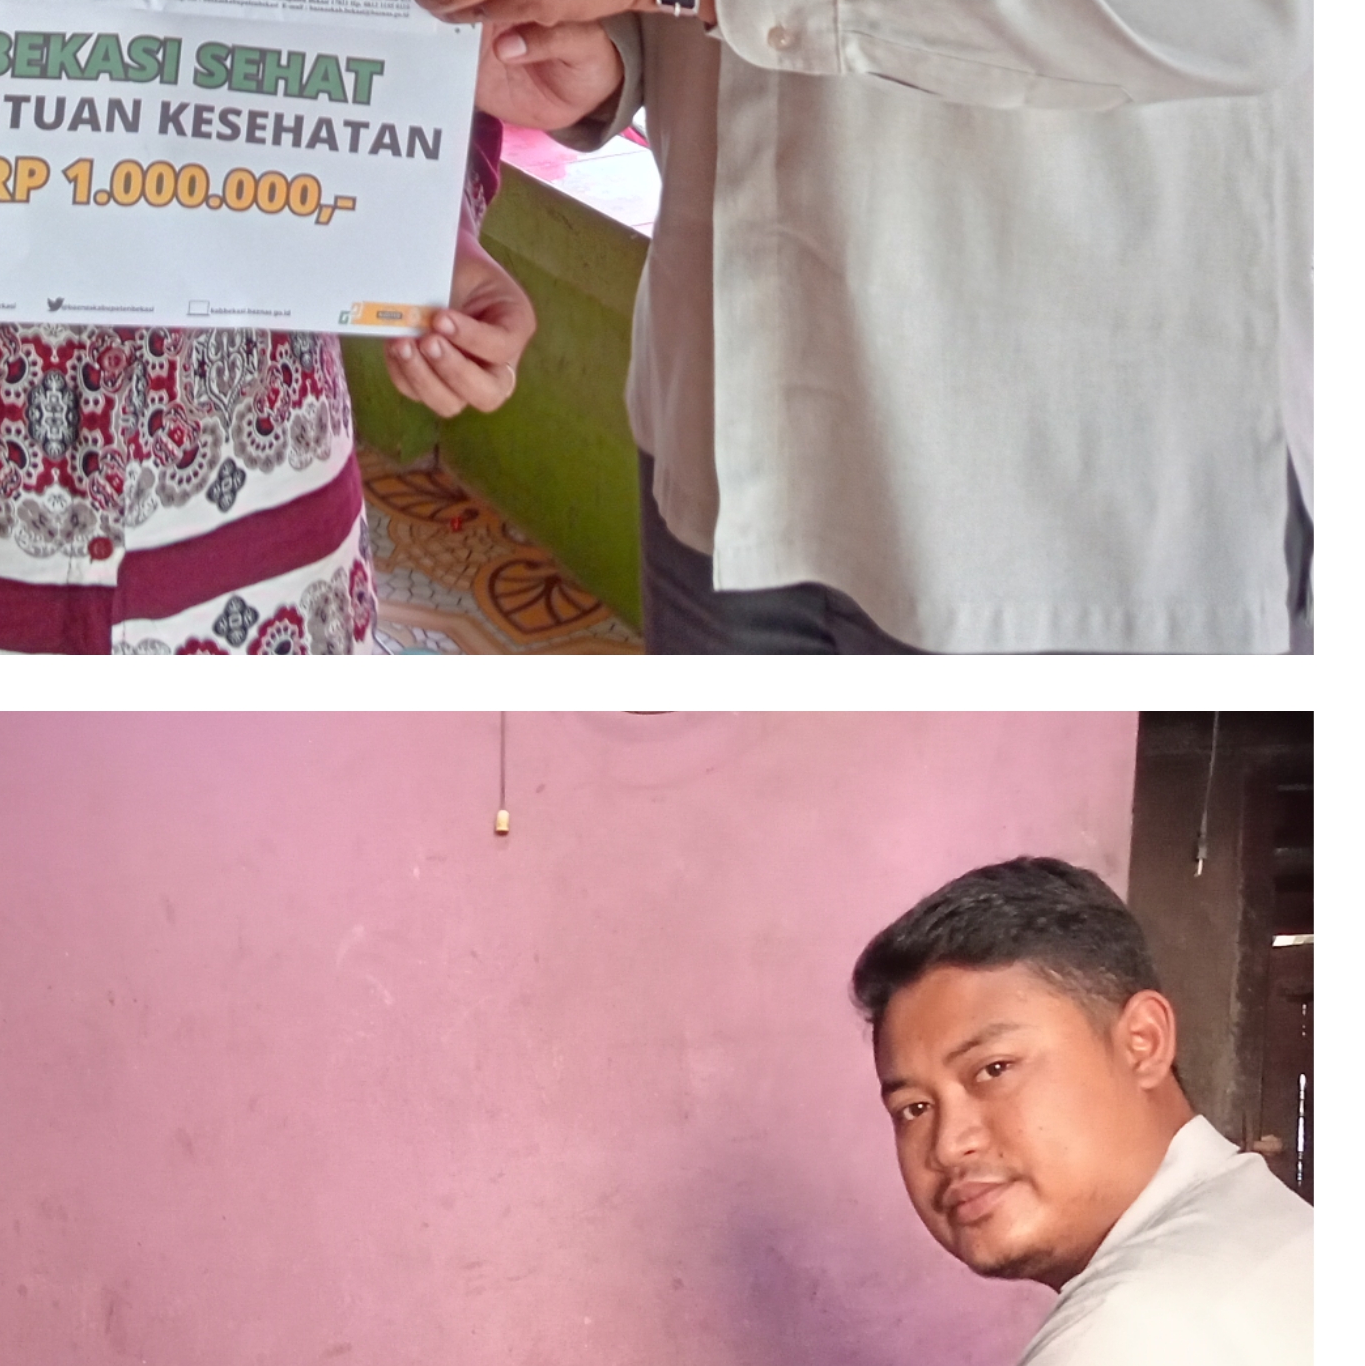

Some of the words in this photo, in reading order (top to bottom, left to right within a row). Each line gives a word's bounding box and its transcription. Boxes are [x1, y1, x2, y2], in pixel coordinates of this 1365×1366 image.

[194, 40, 385, 105] SEHAT
[159, 100, 443, 161] KESEHATAN
[62, 157, 357, 225] 1.000.000,-
